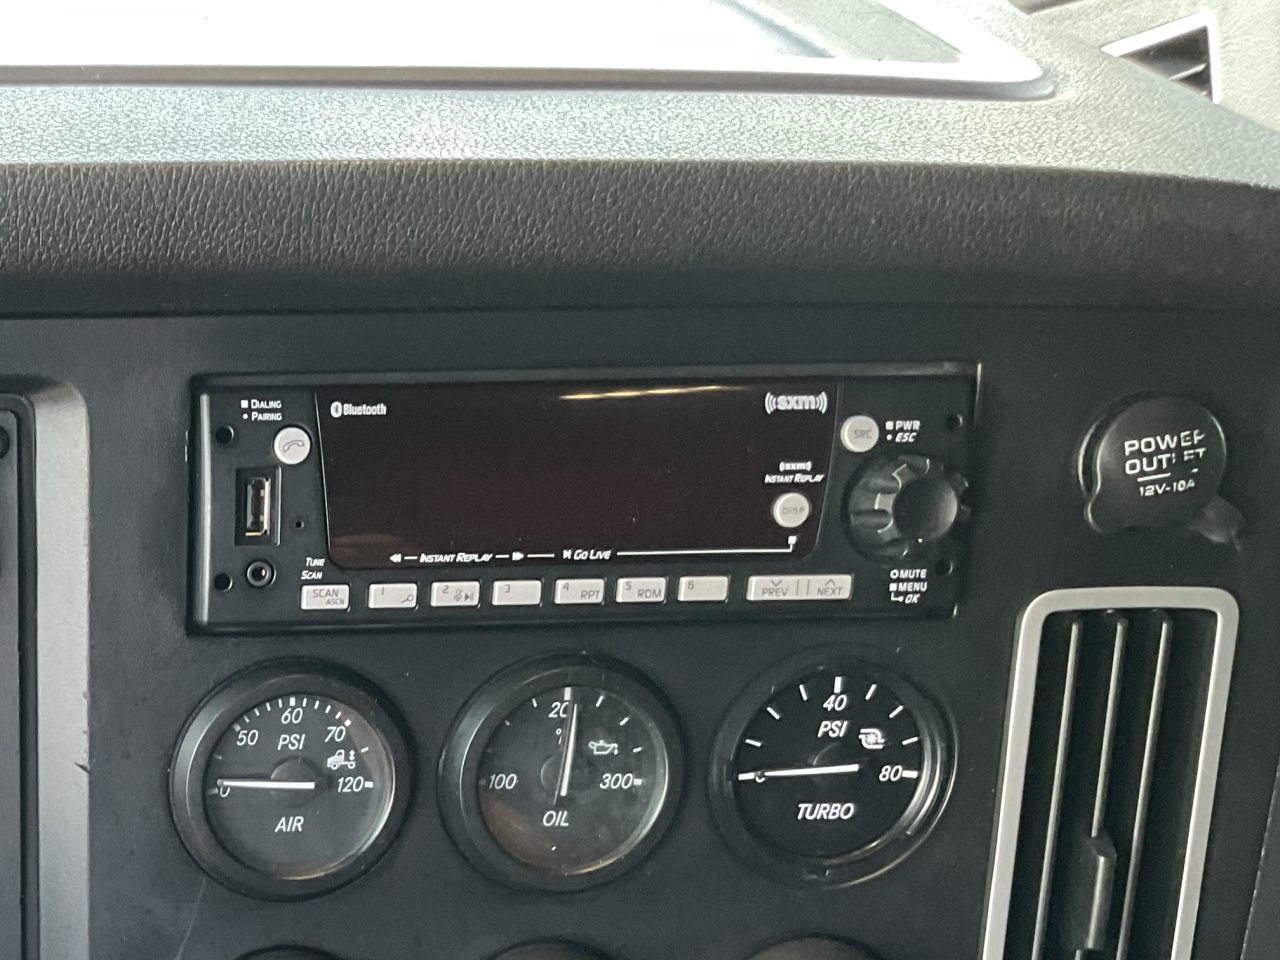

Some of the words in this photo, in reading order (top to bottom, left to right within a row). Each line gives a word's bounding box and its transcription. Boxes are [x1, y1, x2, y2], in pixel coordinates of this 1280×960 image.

[343, 402, 387, 415] Bluetooth
[895, 420, 920, 430] PWR
[854, 429, 873, 439] SRC
[895, 432, 917, 442] ESC
[898, 569, 927, 579] MUTE
[442, 585, 449, 593] 2
[504, 584, 511, 593] 3
[625, 582, 632, 591] 5
[687, 581, 695, 590] 6
[898, 582, 927, 591] MENU
[312, 588, 339, 598] SCAN
[580, 590, 600, 600] RPT
[761, 588, 788, 596] PREV
[817, 587, 843, 596] NEXT
[905, 594, 921, 604] OK
[823, 694, 847, 711] 40
[281, 707, 303, 724] 60
[325, 726, 346, 743] 70
[817, 720, 848, 738] PSI
[237, 729, 259, 746] 50
[277, 733, 305, 750] PSI
[879, 765, 902, 782] 80
[337, 777, 364, 793] 120
[489, 774, 517, 790] 100
[600, 773, 633, 789] 300
[797, 803, 855, 820] TURBO
[542, 810, 569, 827] OIL
[275, 816, 304, 833] AIR
